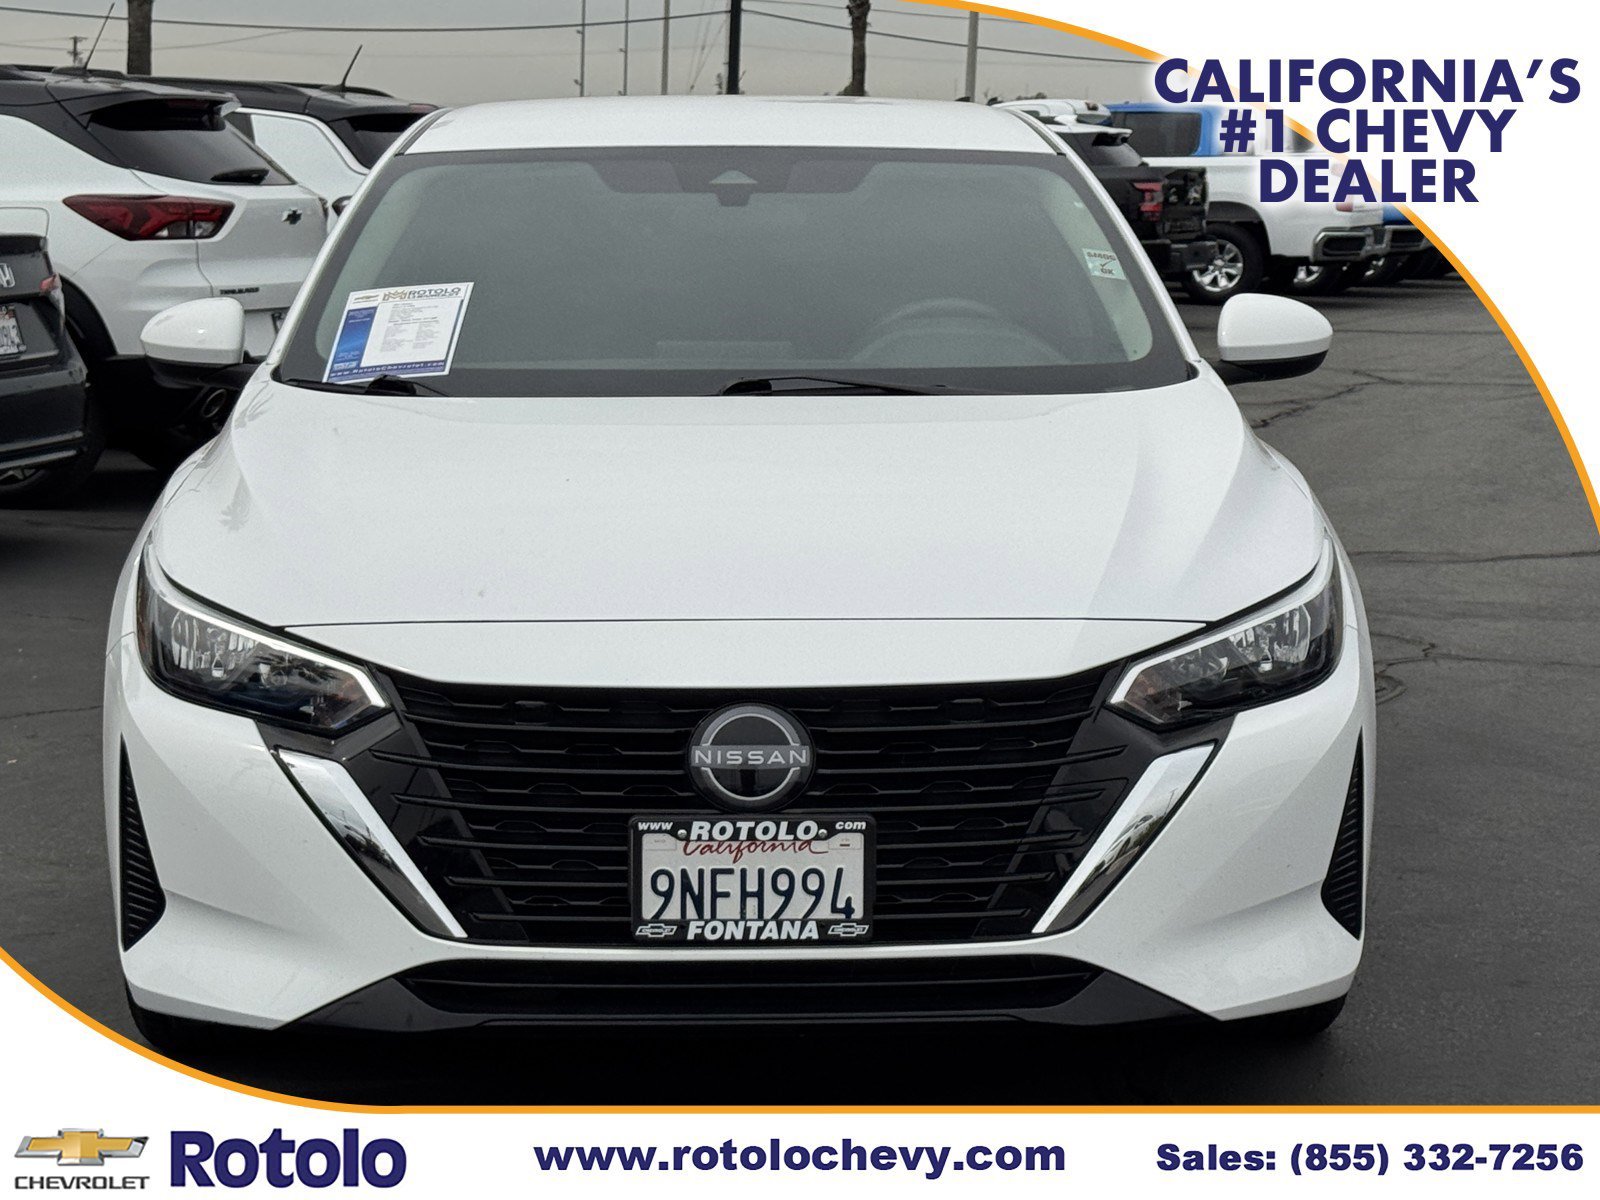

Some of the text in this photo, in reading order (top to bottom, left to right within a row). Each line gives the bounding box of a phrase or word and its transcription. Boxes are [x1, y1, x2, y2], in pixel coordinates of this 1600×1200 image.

[694, 749, 807, 765] NISSAN
[637, 820, 867, 842] www ROTOLO com
[683, 840, 829, 864] California
[650, 867, 856, 920] 9NFH994
[686, 920, 820, 941] FONTANA
